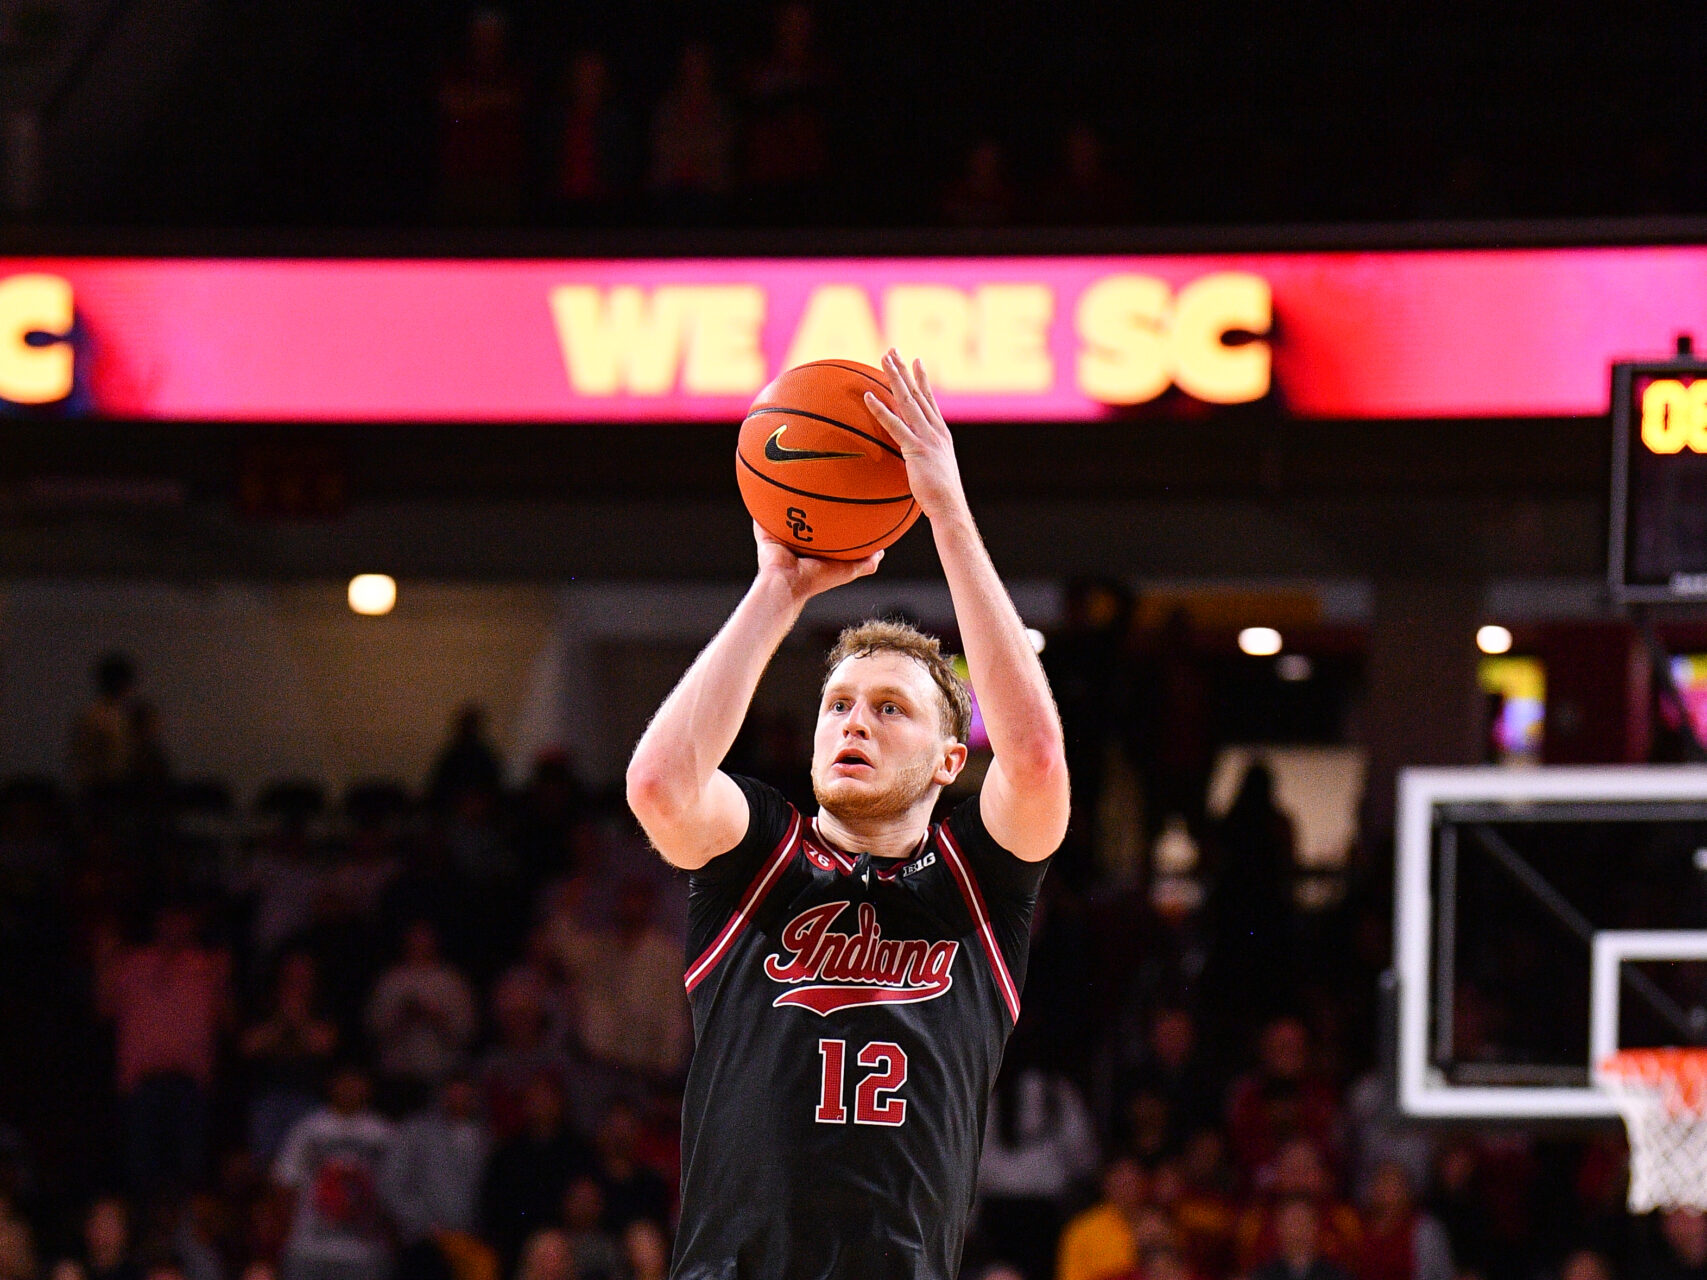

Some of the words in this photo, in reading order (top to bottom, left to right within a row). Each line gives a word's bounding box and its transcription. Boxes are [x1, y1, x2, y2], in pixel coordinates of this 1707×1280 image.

[551, 284, 766, 396] WE
[783, 283, 1056, 396] ARE
[1075, 270, 1274, 405] SC
[786, 506, 813, 543] SC
[763, 901, 960, 992] Indiana
[815, 1038, 908, 1127] 12
